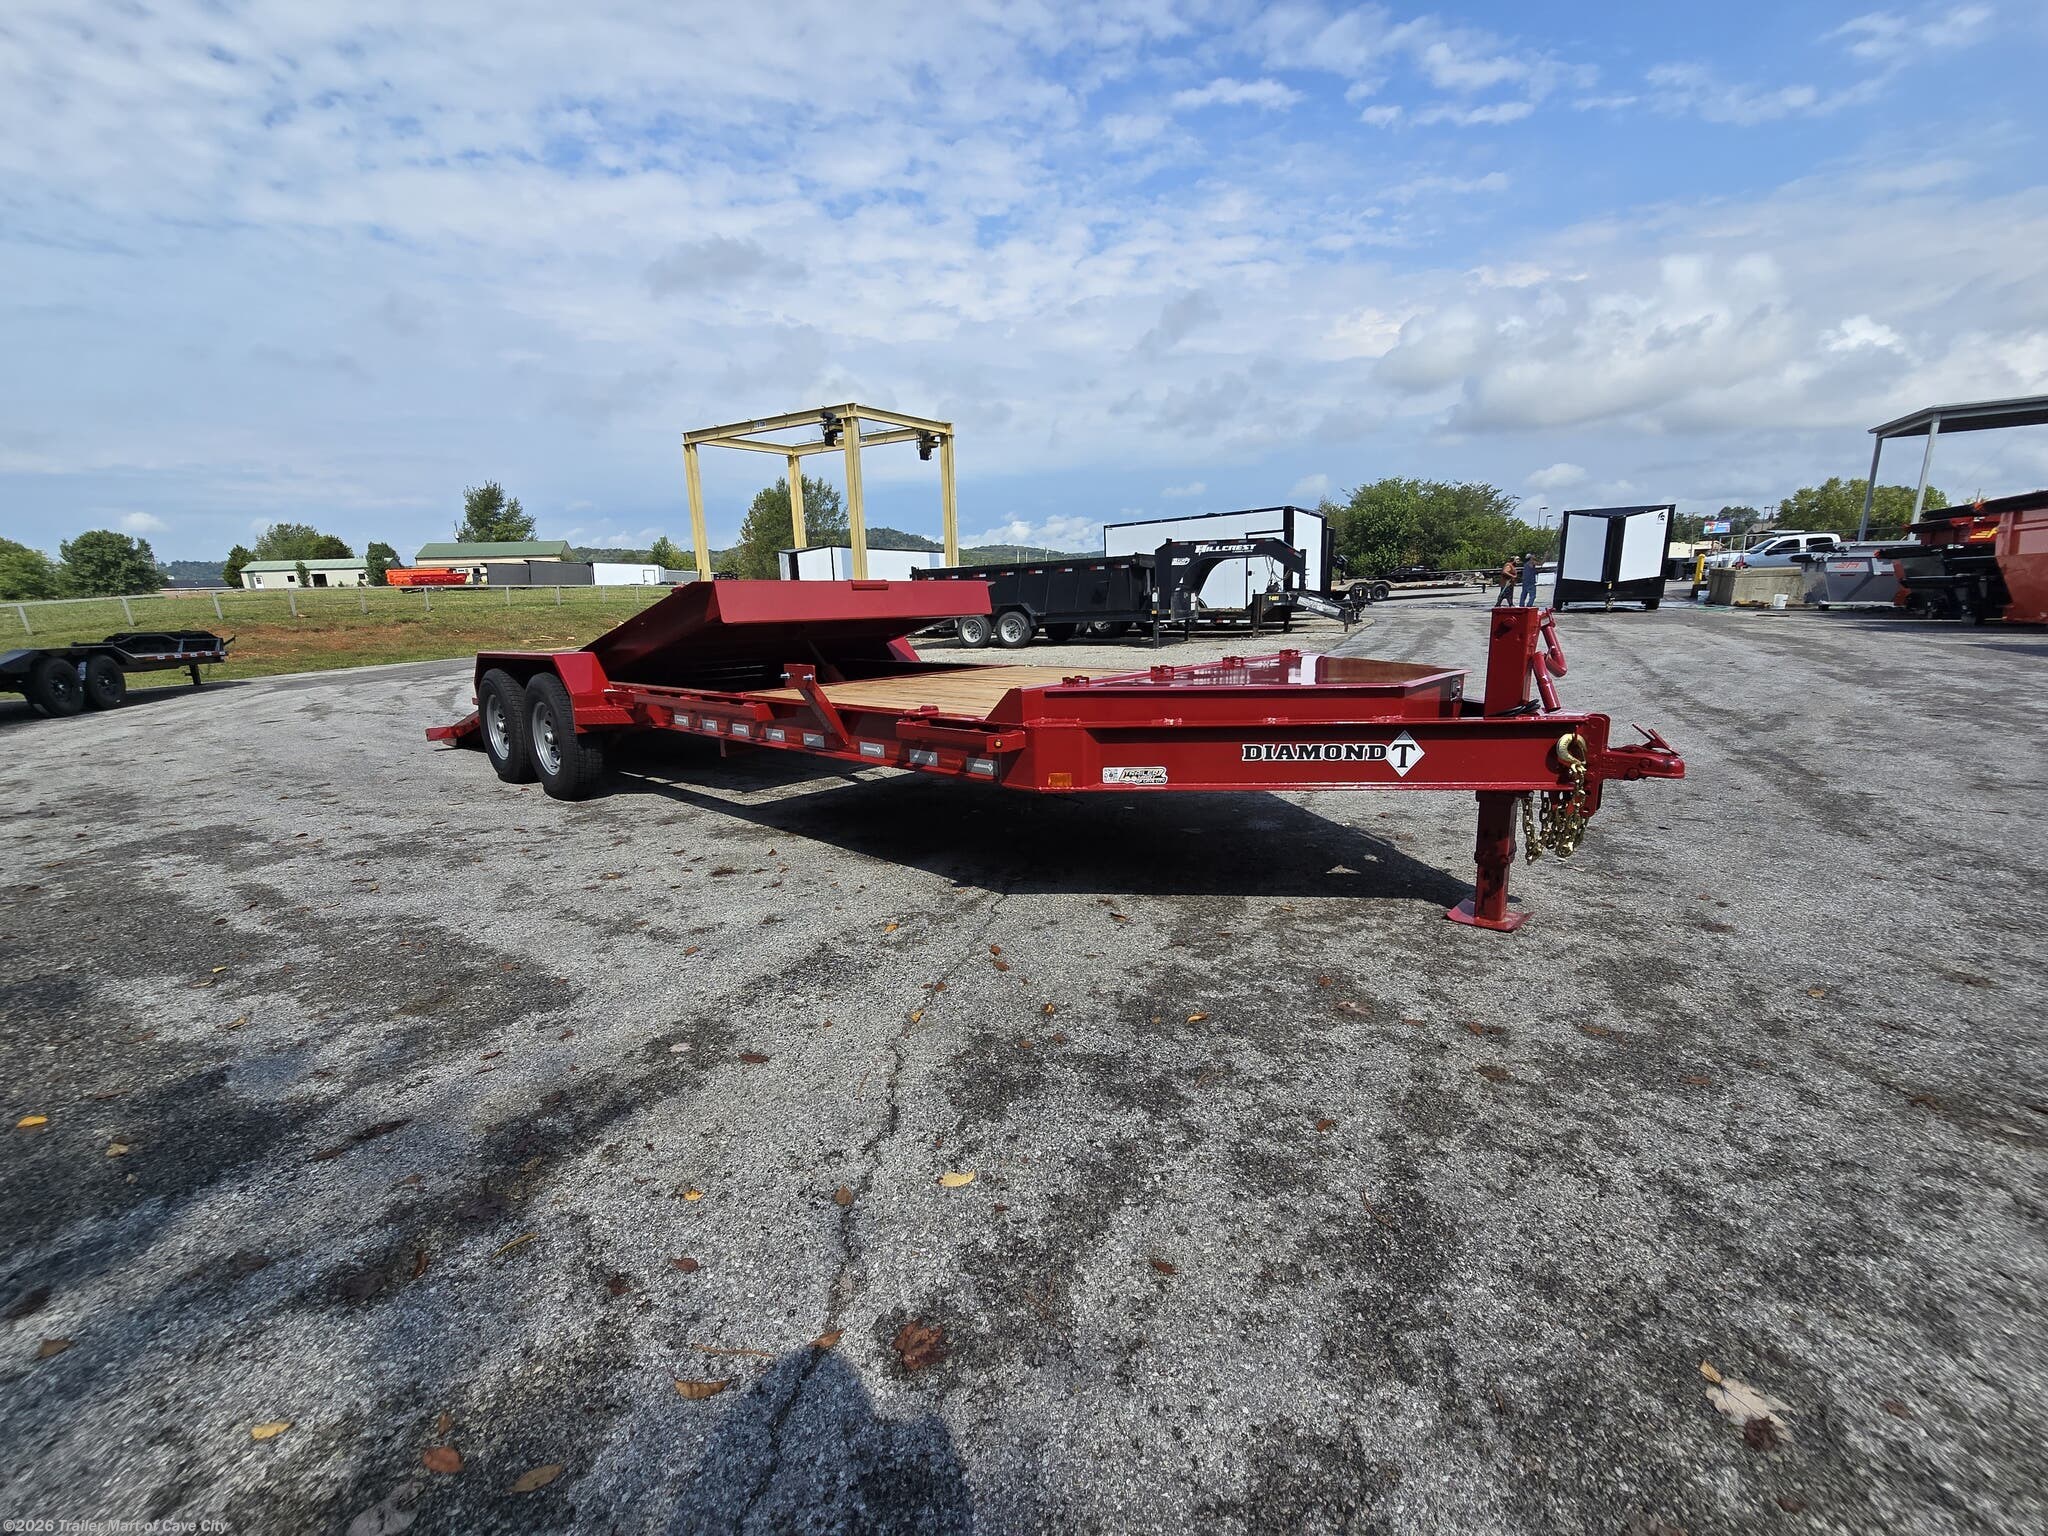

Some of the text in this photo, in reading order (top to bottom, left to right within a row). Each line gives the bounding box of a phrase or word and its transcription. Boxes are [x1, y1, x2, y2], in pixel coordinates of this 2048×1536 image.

[1194, 544, 1257, 556] HILLCREST
[1242, 743, 1416, 768] DIAMOND T
